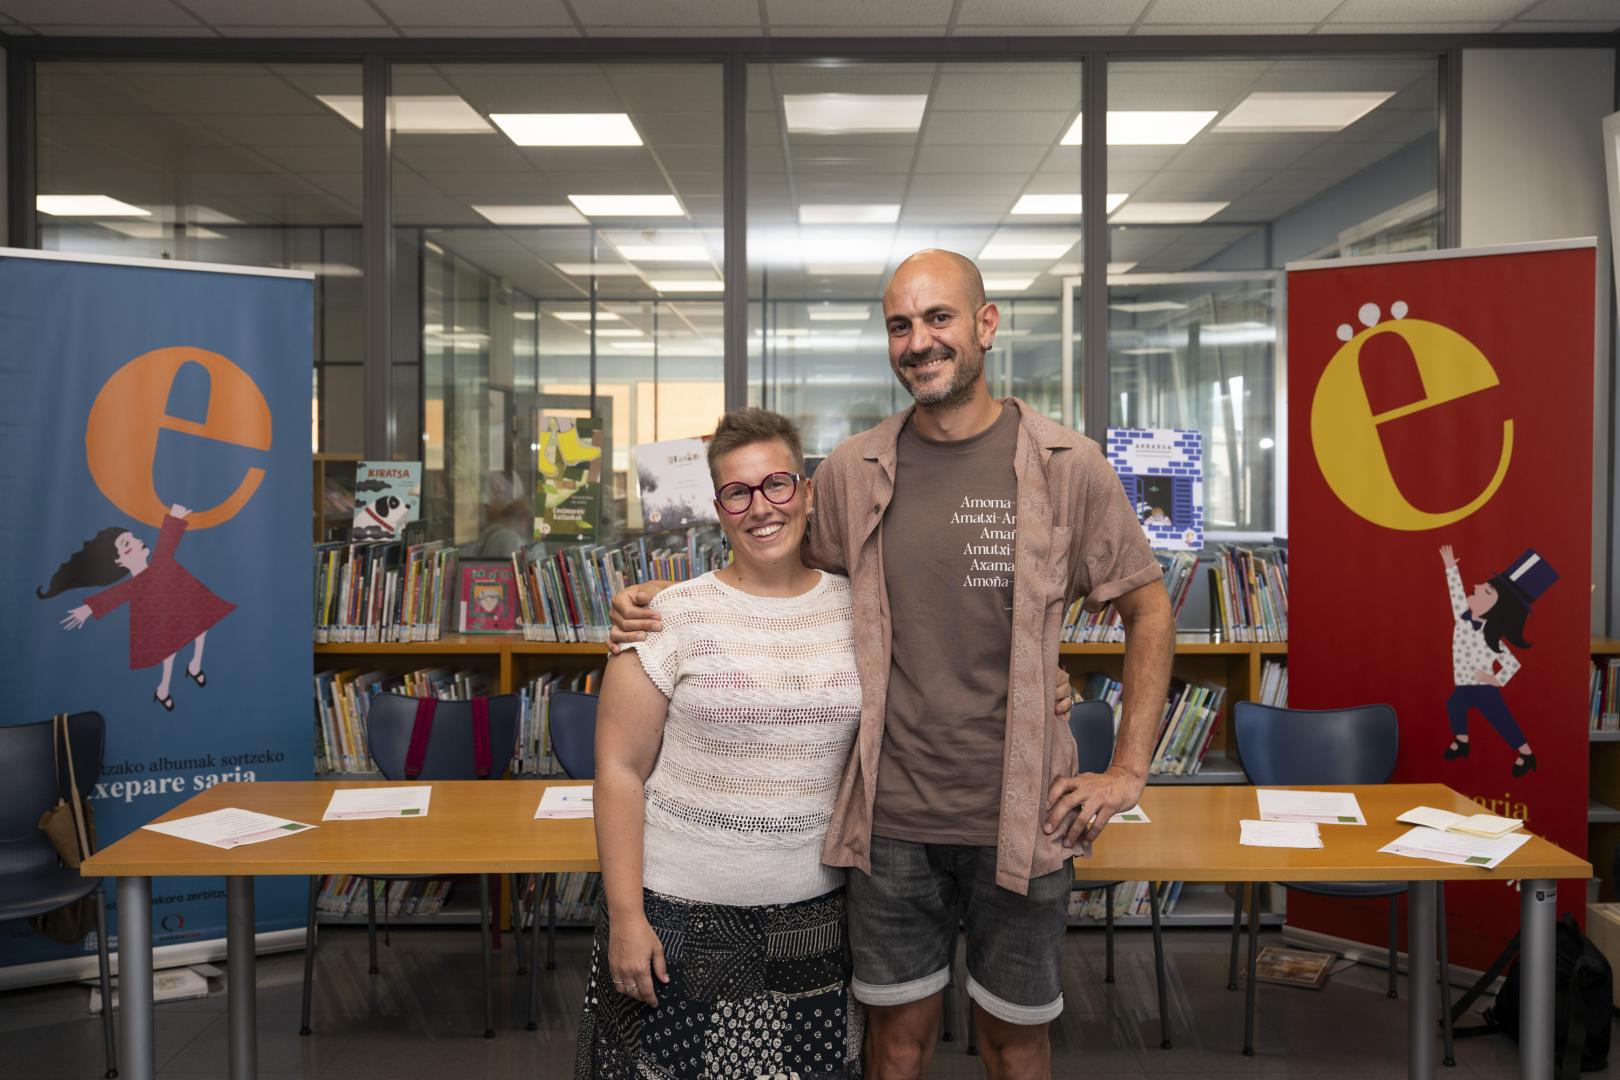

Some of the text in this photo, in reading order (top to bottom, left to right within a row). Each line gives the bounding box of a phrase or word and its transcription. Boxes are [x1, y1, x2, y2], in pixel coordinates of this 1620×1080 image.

[368, 469, 410, 478] KIRATSA
[150, 754, 216, 773] albumak
[221, 749, 285, 767] sortzeko
[87, 766, 256, 803] xepare saria
